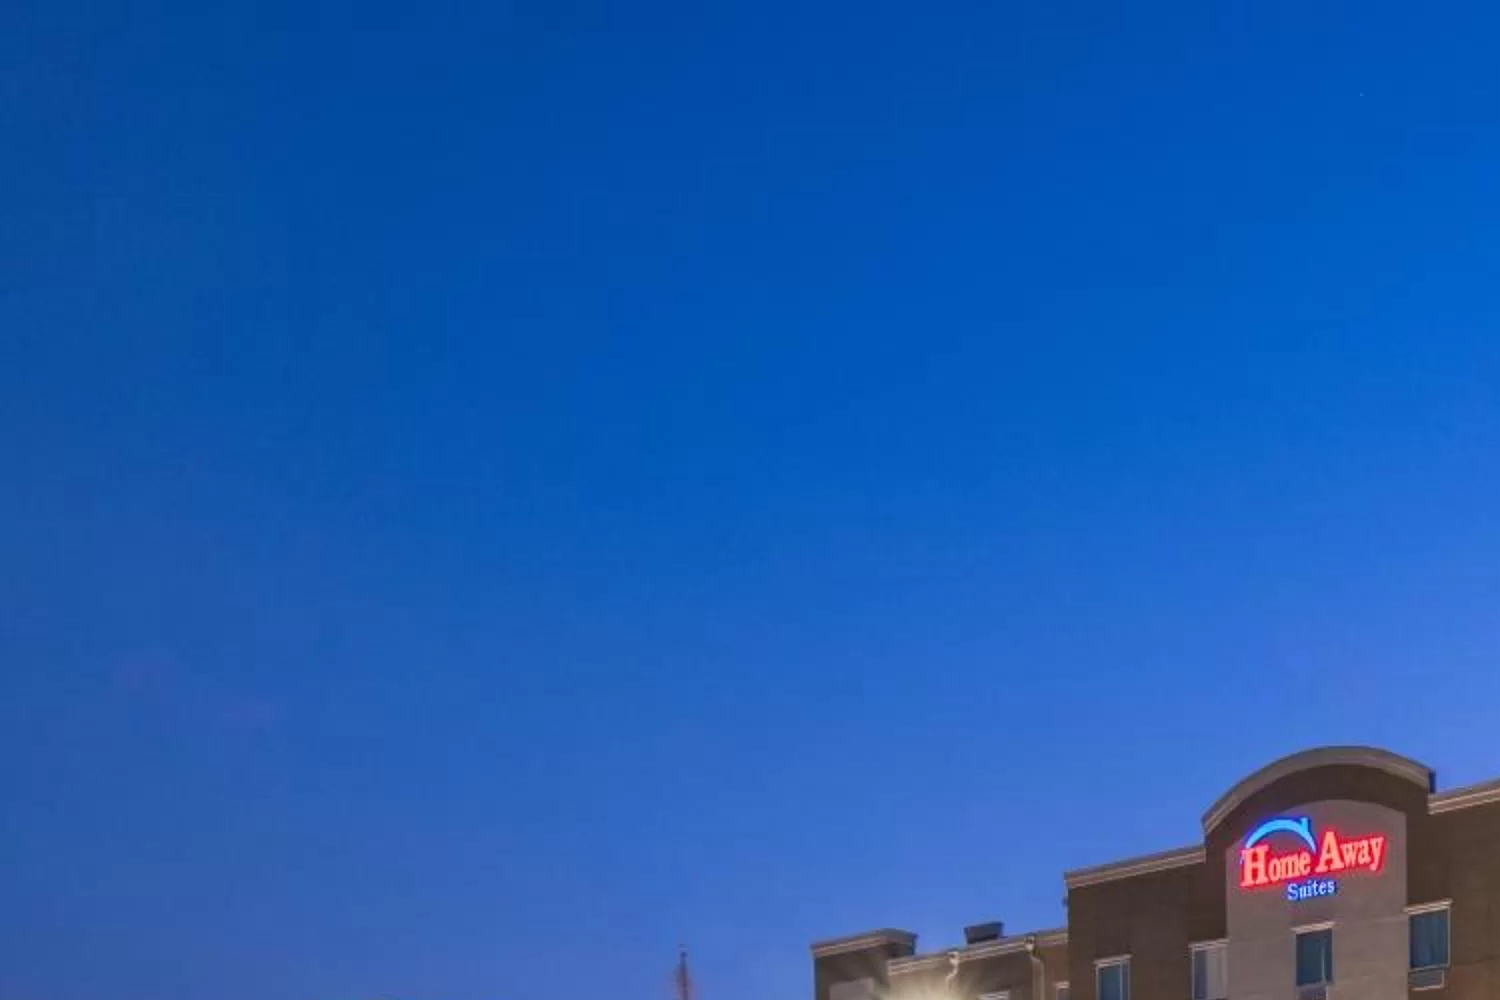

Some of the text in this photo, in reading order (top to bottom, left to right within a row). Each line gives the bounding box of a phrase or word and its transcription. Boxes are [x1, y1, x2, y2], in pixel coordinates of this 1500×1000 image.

[1240, 831, 1384, 887] Home Away
[1287, 880, 1336, 901] Suites
